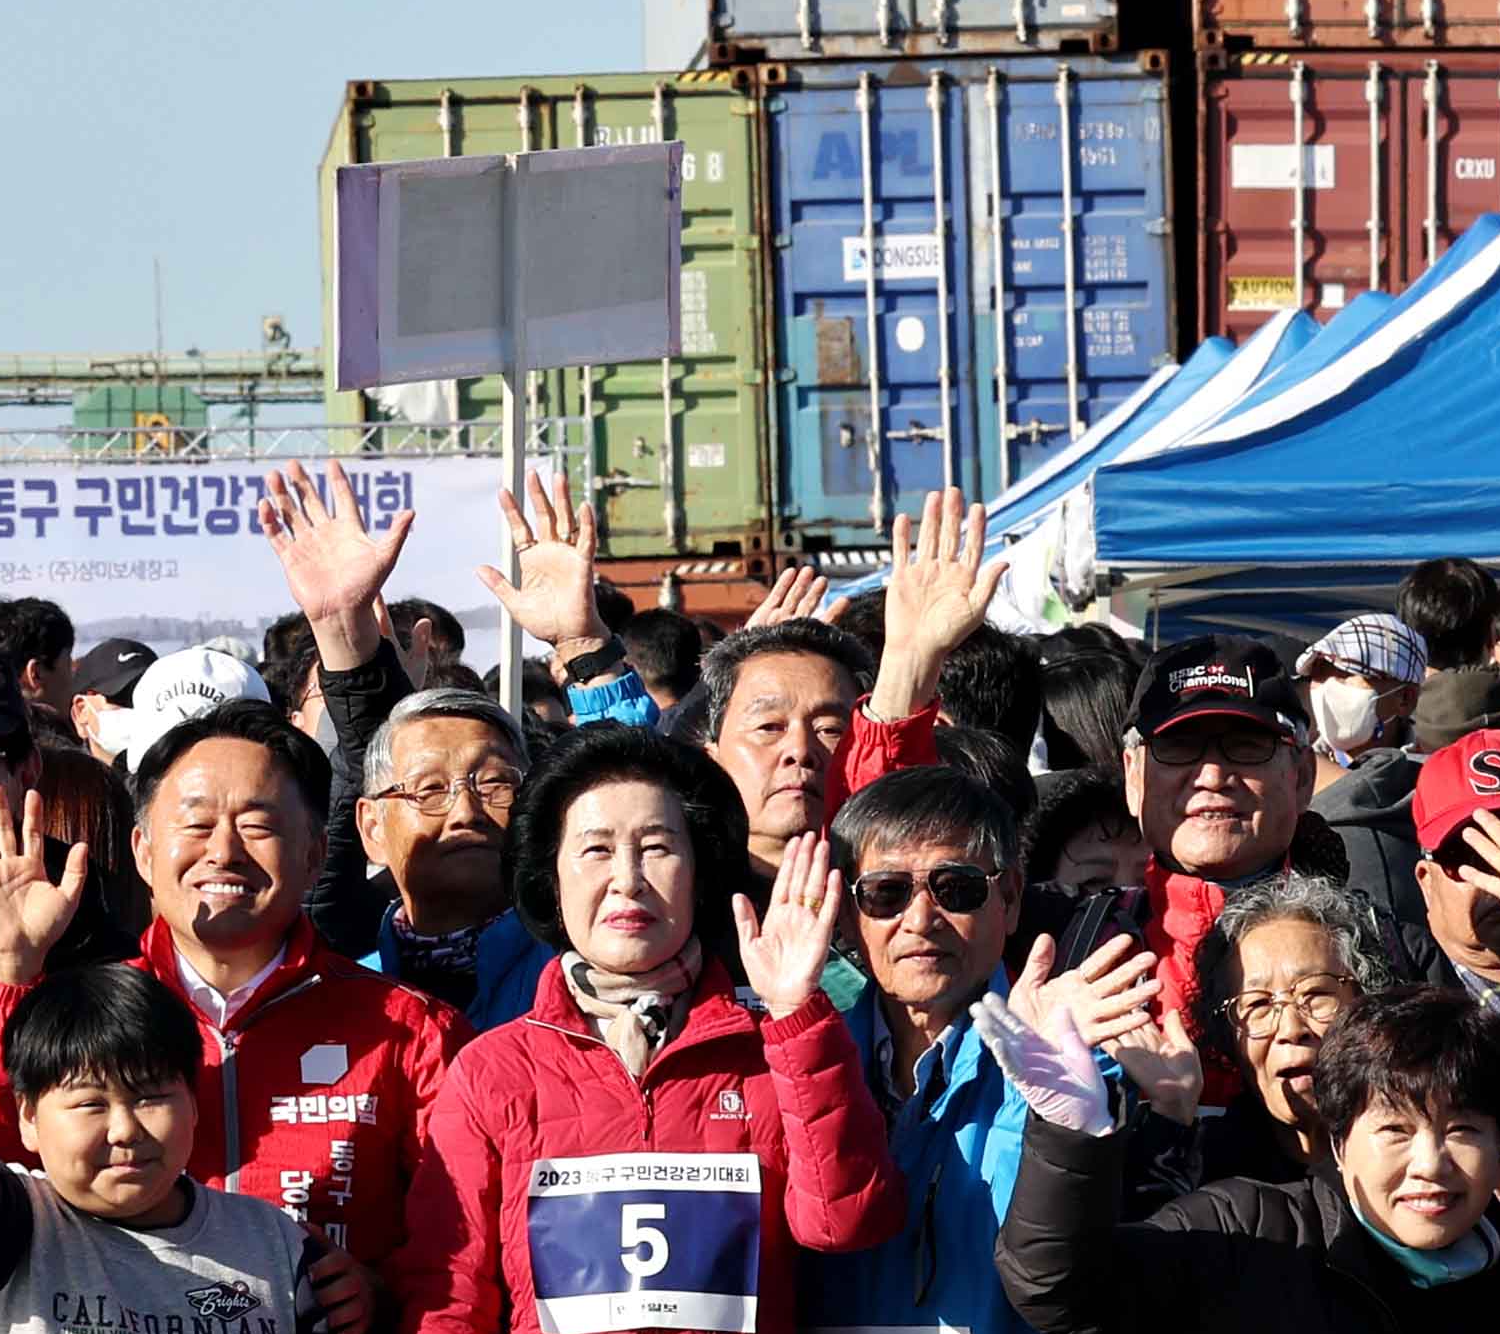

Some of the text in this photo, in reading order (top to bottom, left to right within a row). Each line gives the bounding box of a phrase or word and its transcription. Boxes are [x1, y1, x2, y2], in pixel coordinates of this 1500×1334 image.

[1455, 157, 1496, 180] CRXU
[1170, 666, 1205, 682] HSBC
[1170, 673, 1248, 693] Champions
[156, 679, 226, 713] Callawa
[270, 1094, 378, 1125] 국민의힘
[540, 1170, 581, 1187] 2023
[620, 1165, 750, 1184] 구민건강걷기대회
[619, 1203, 670, 1277] 5
[198, 1292, 251, 1320] Brights
